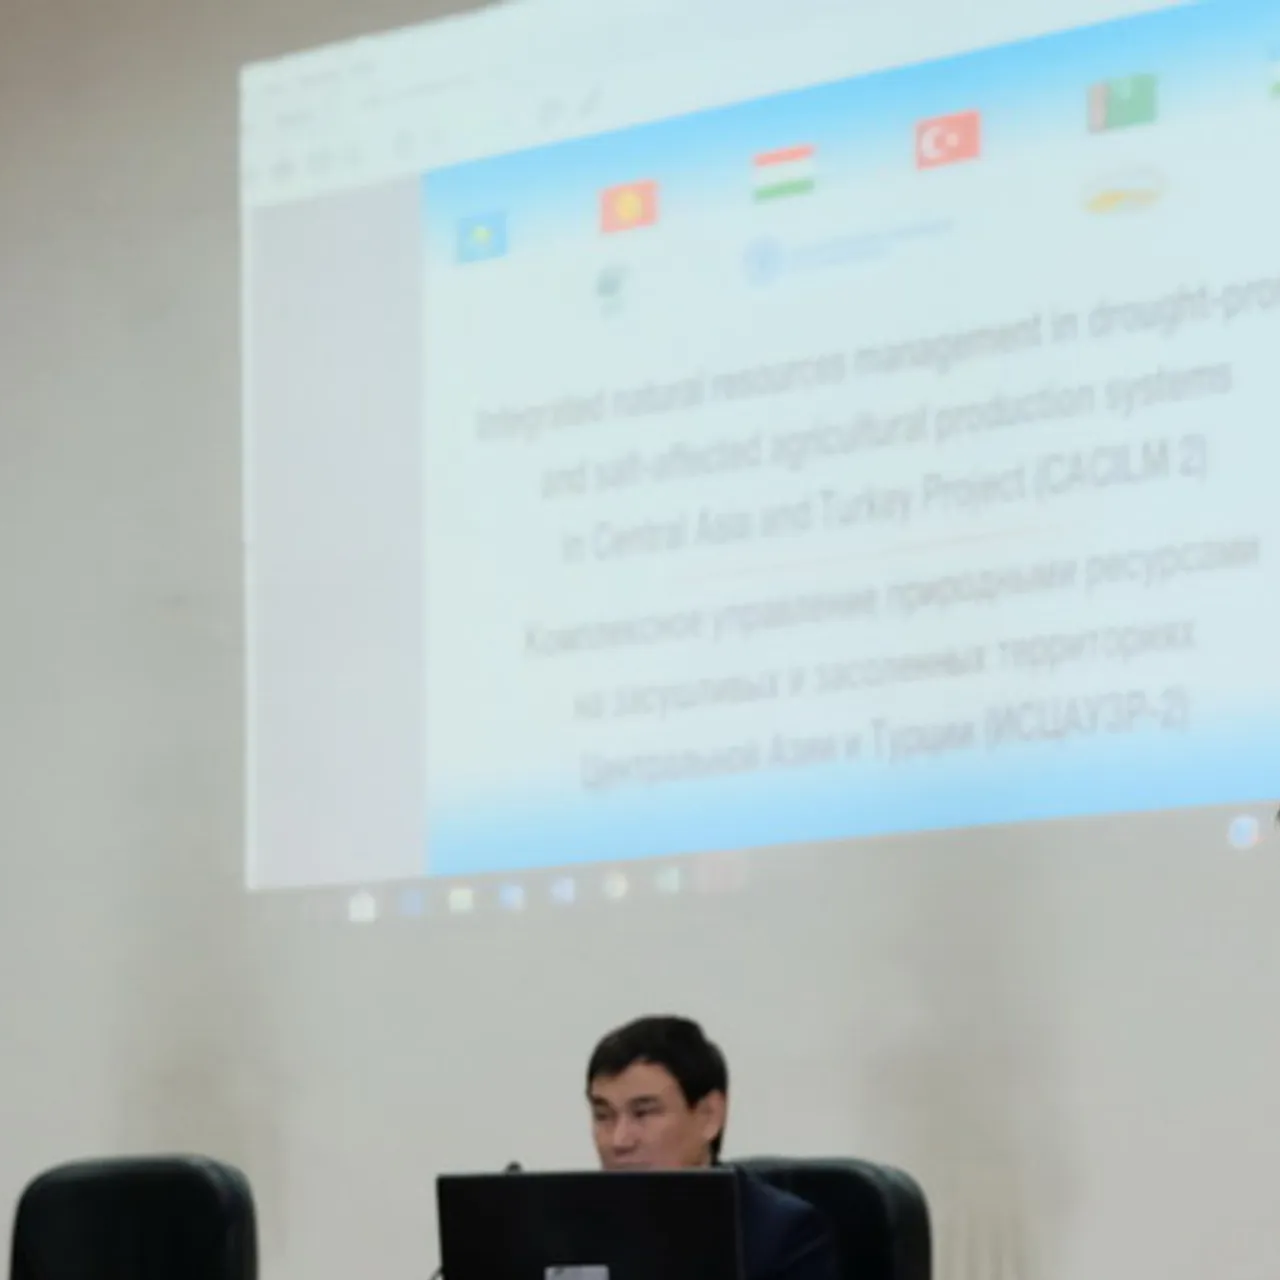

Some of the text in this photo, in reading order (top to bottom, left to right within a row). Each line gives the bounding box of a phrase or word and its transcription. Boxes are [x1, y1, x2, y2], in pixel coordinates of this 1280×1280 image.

[853, 314, 1042, 374] management
[1050, 312, 1078, 342] in
[935, 383, 1095, 446] production
[1105, 362, 1233, 416] systems
[592, 513, 687, 561] Central
[694, 504, 753, 546] Asia
[819, 487, 912, 532] Turkey
[922, 466, 1026, 510] Project
